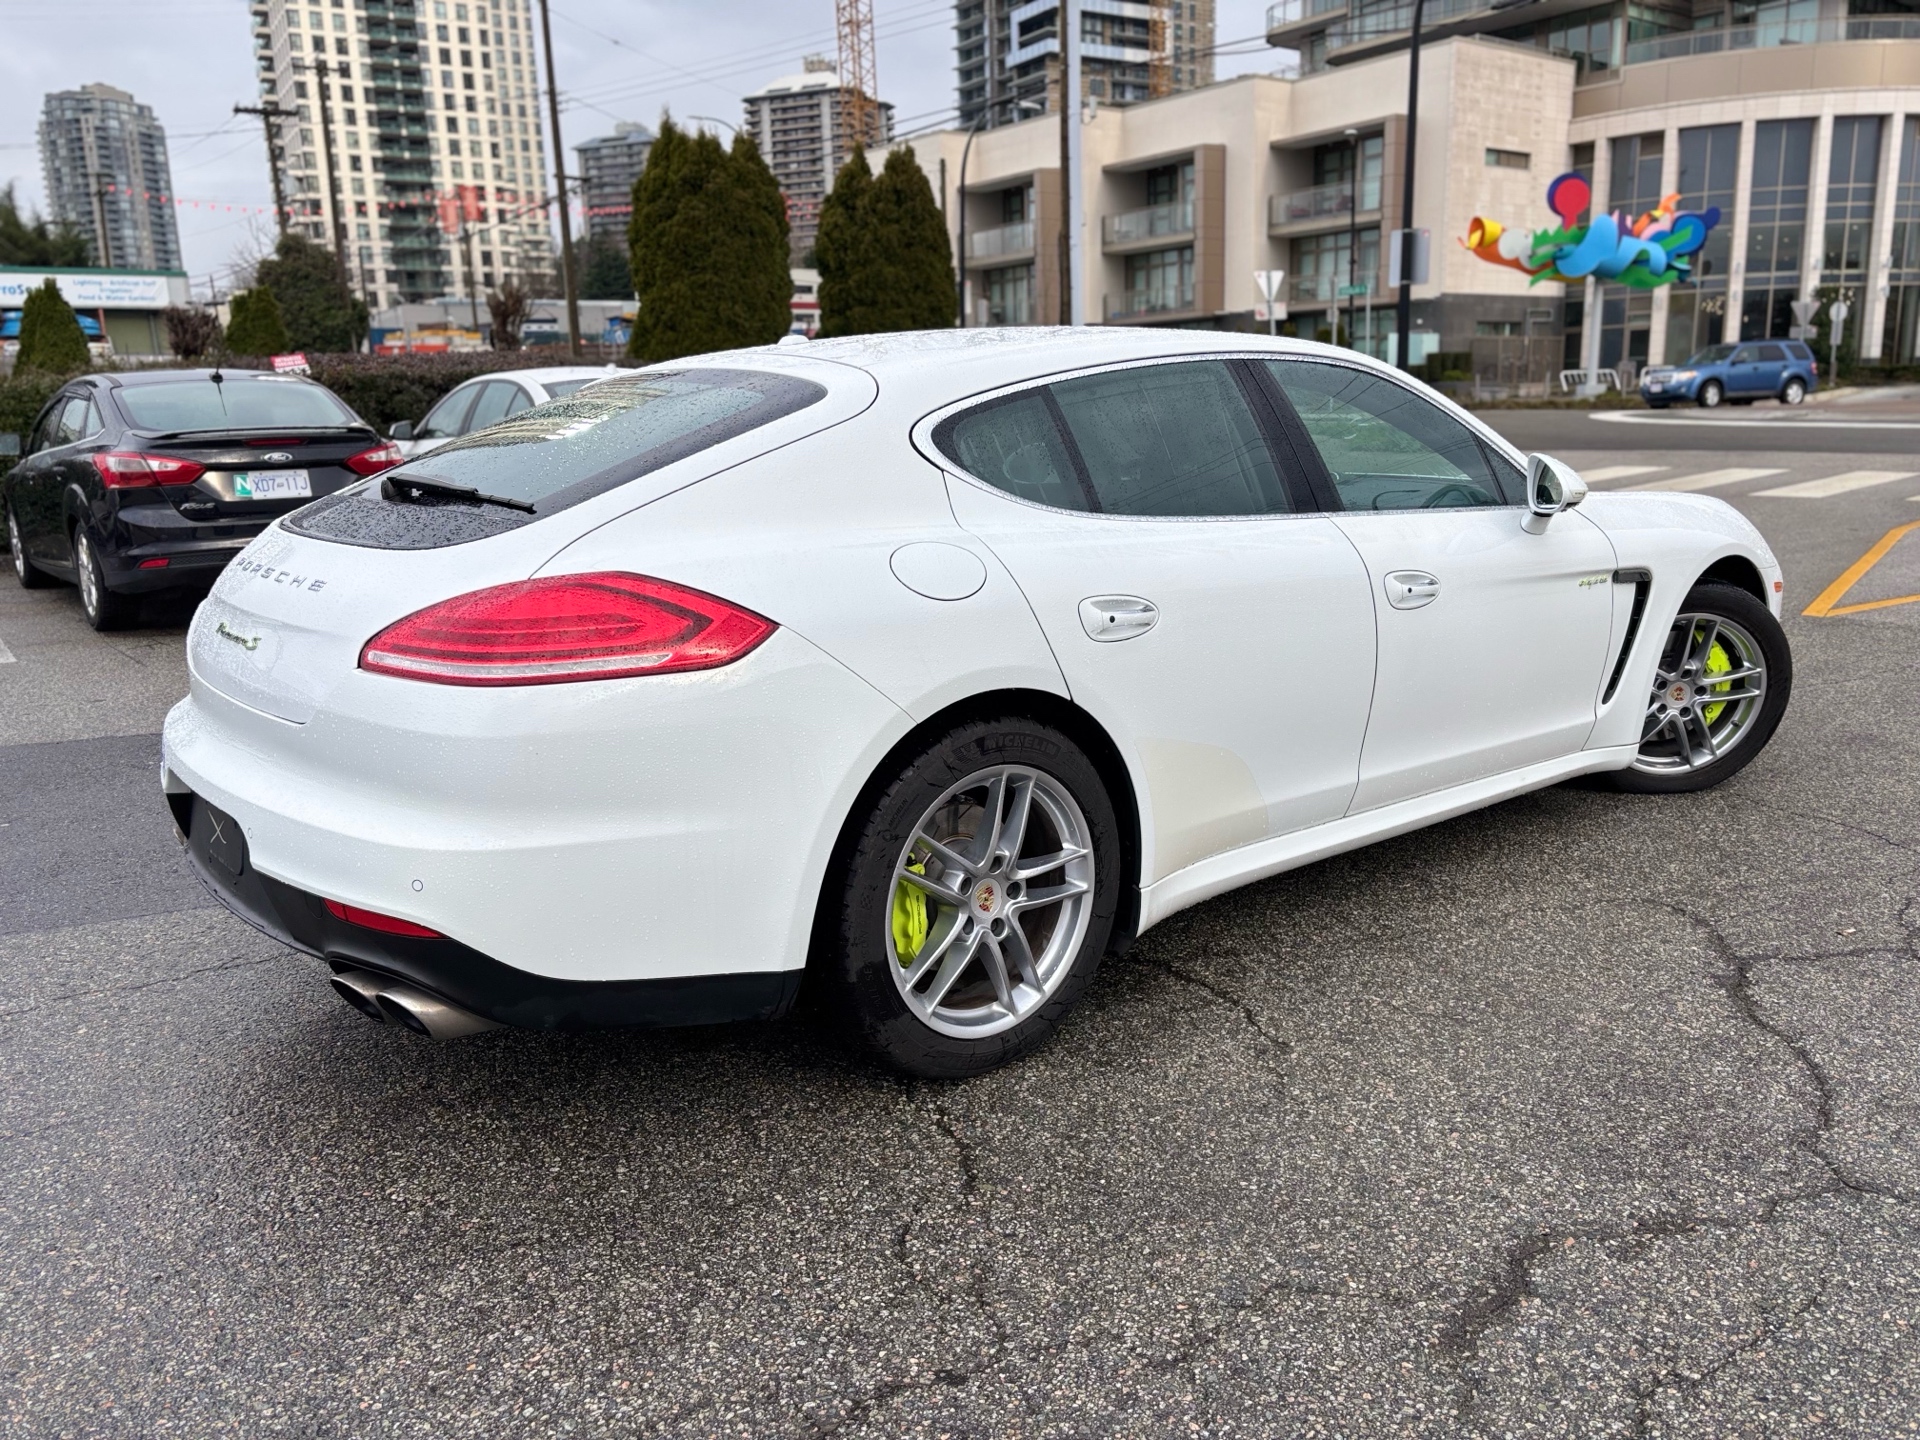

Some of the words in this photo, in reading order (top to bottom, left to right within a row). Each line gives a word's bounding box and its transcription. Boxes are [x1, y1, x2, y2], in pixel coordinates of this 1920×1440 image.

[236, 476, 250, 490] N
[236, 557, 327, 592] PORSCHE
[984, 734, 1058, 756] MICHELIN
[889, 798, 909, 827] MICHELIN
